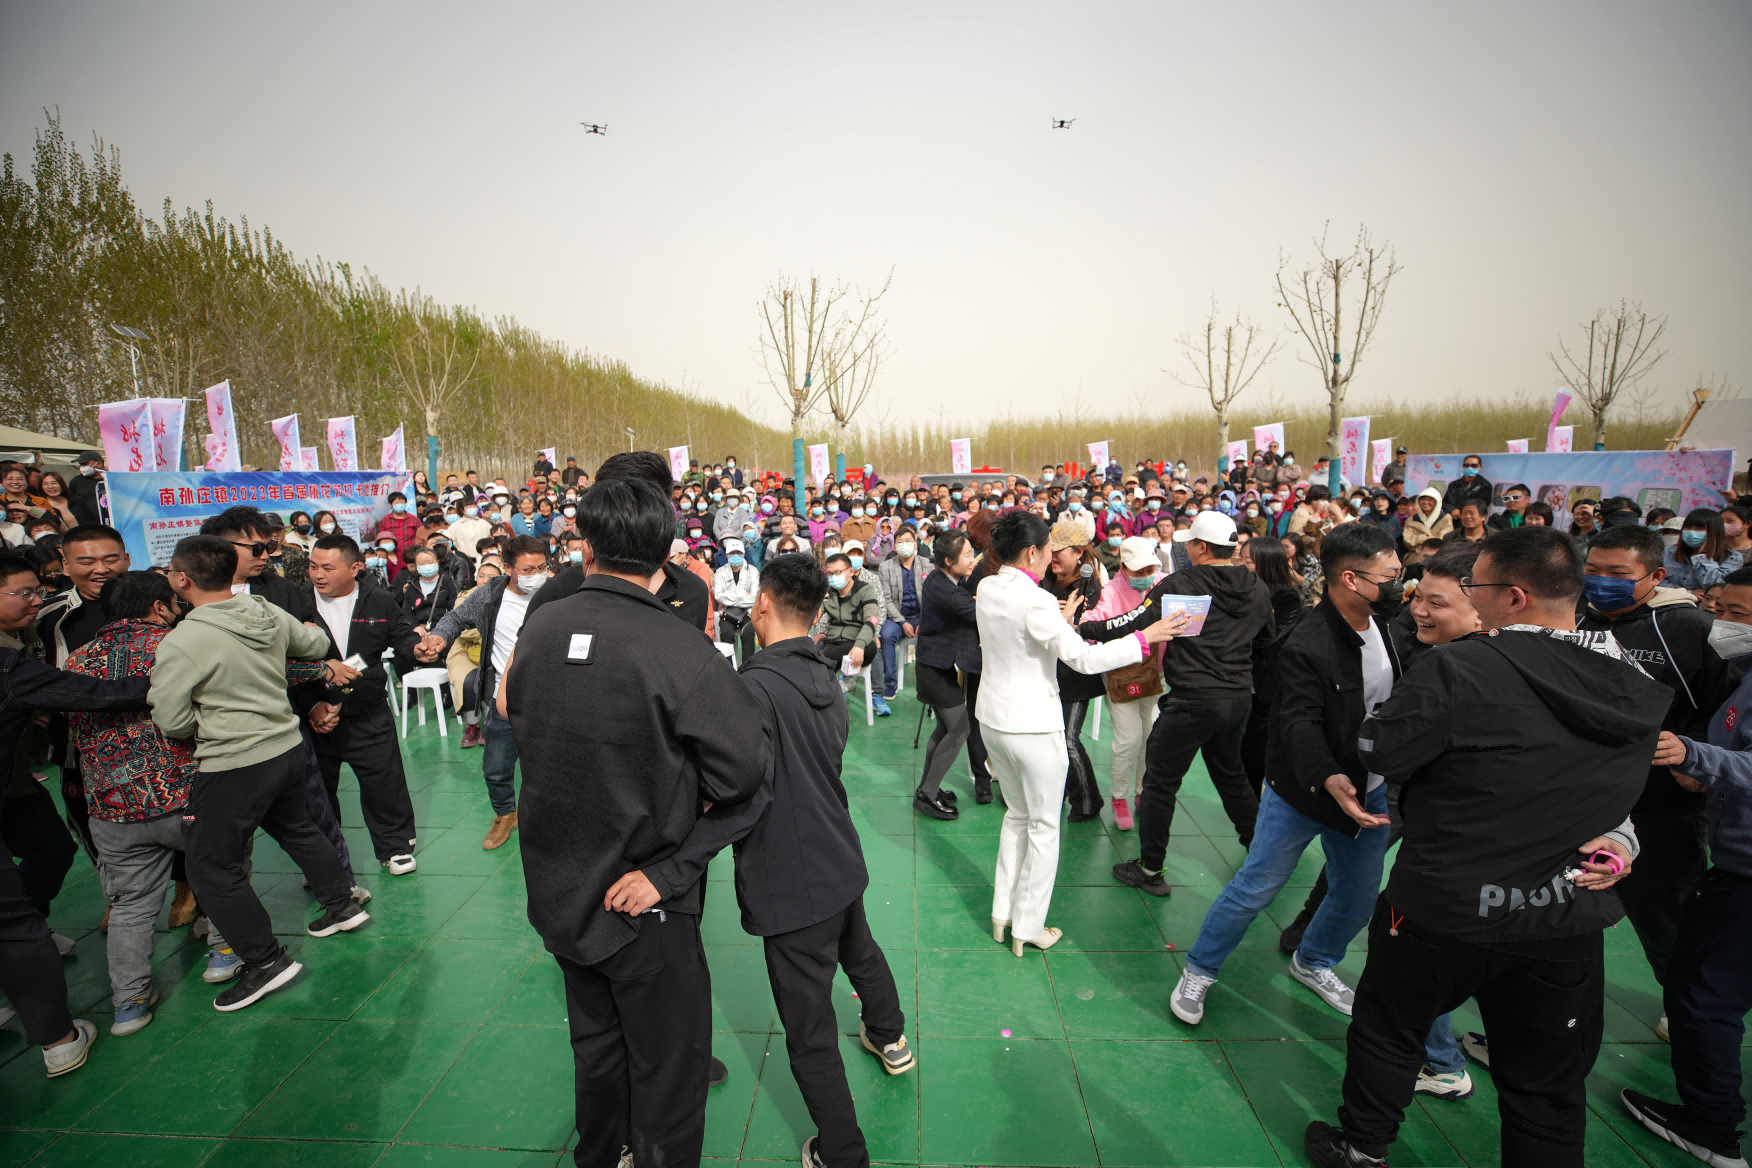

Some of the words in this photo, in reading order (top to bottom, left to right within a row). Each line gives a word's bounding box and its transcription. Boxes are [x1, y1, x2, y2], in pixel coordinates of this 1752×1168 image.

[149, 518, 208, 530] 南孙庄镇整体
[1129, 686, 1140, 695] 31
[1726, 709, 1736, 726] 26
